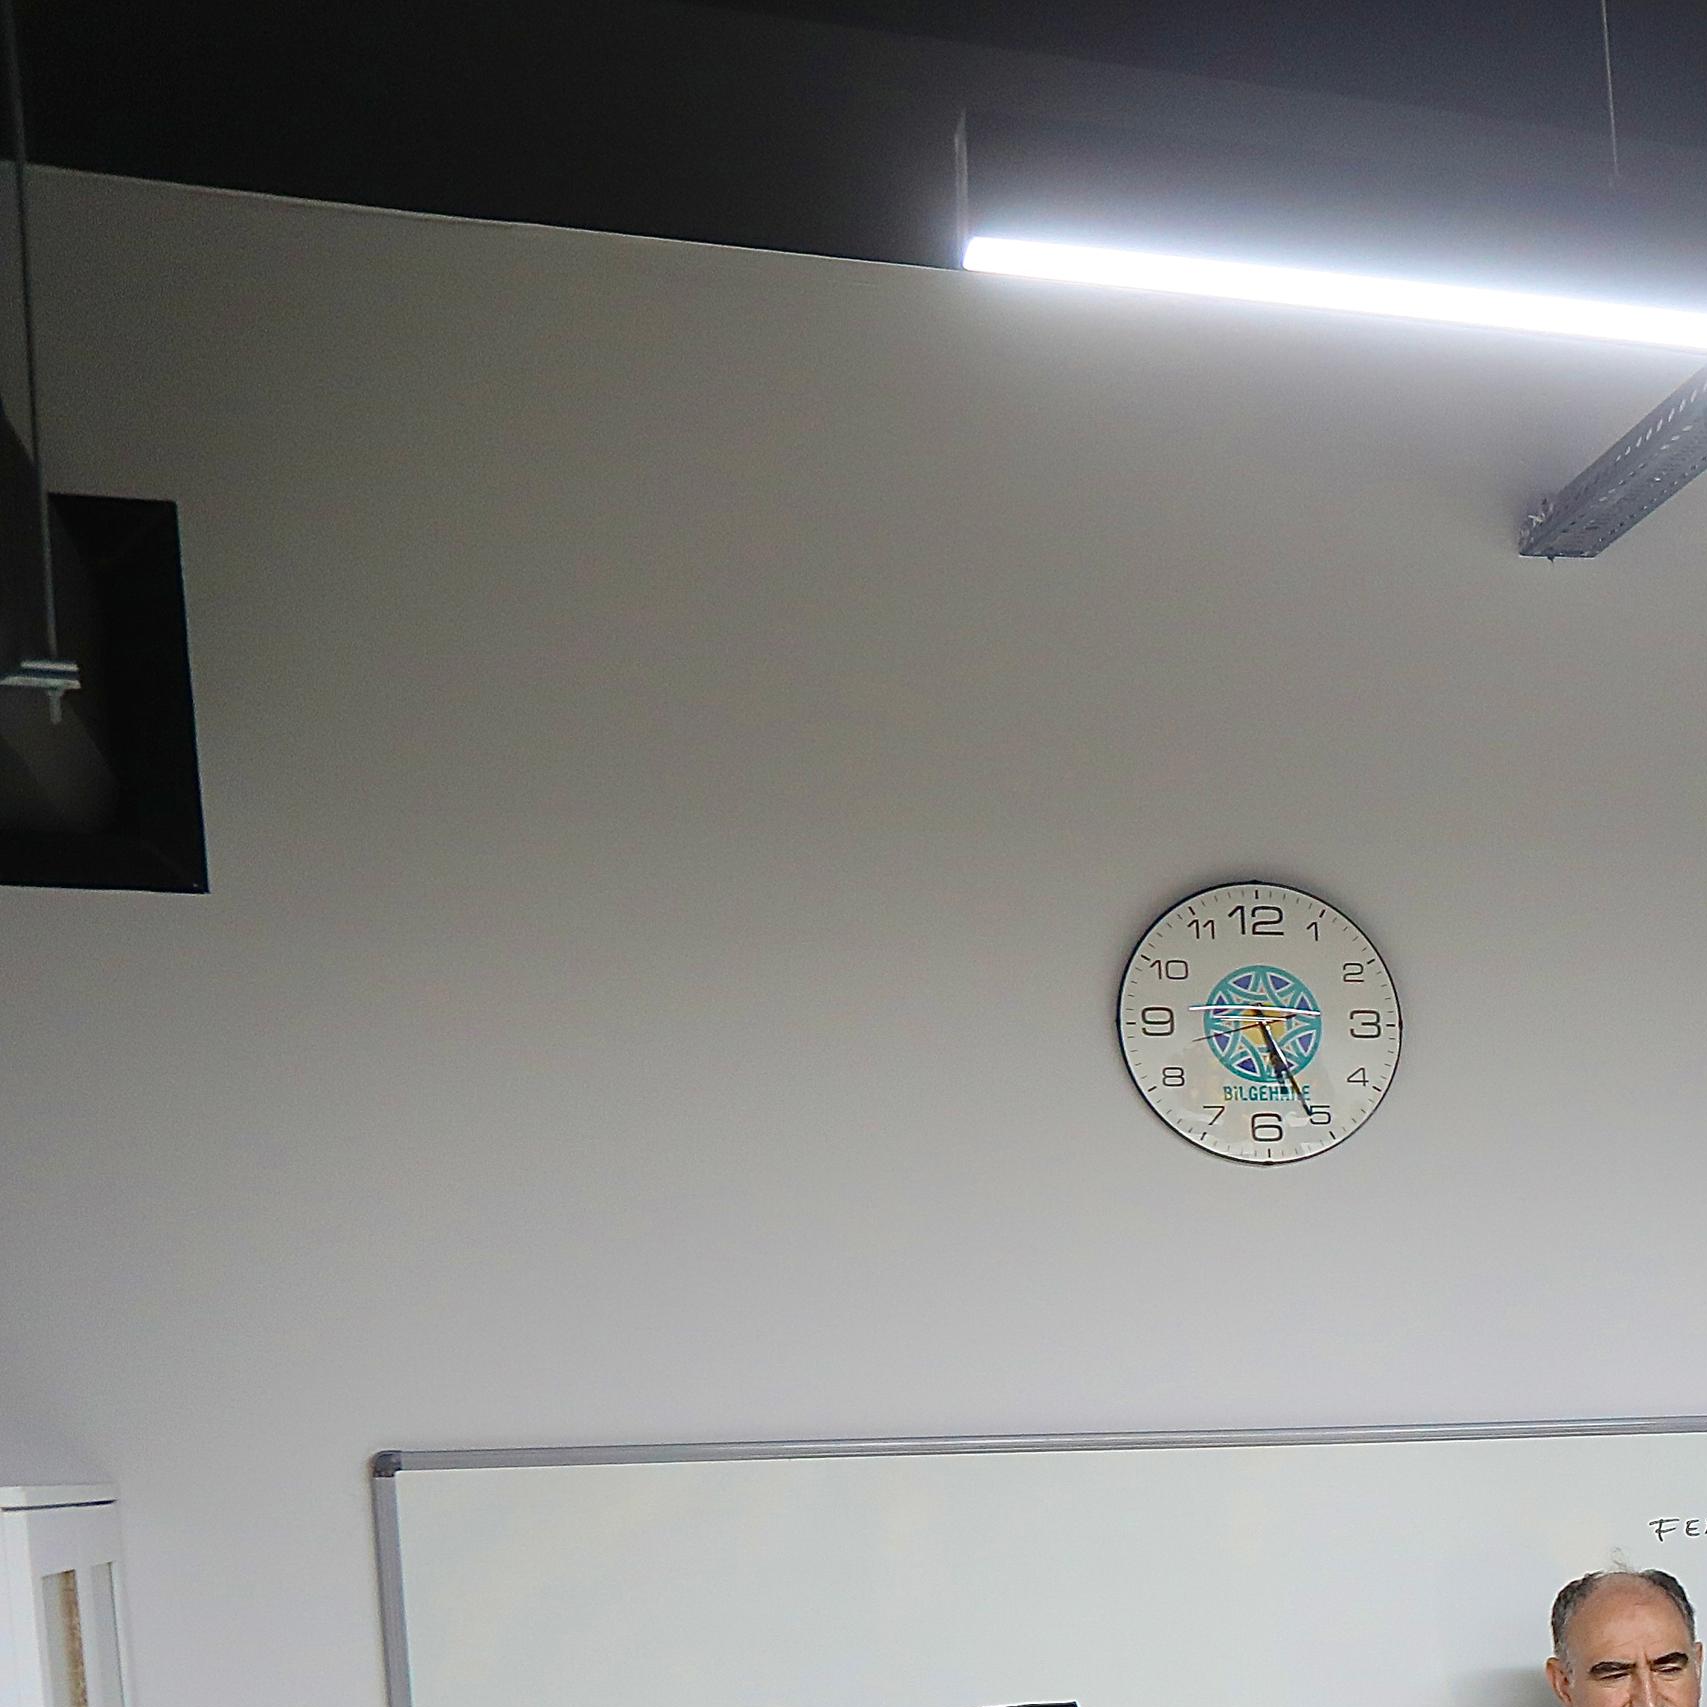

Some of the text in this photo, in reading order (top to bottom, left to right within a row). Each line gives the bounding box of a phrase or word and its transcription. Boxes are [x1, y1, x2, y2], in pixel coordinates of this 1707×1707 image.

[1187, 919, 1216, 940] 11
[1228, 905, 1284, 936] 12
[1306, 921, 1320, 941] 1
[1150, 959, 1189, 980] 10
[1342, 962, 1365, 983] 2
[1141, 1006, 1175, 1036] 9
[1349, 1009, 1382, 1039] 3
[1162, 1066, 1185, 1087] 8
[1347, 1067, 1369, 1087] 4
[1203, 1105, 1226, 1126] 7
[1309, 1105, 1332, 1126] 5
[1251, 1112, 1283, 1142] 6
